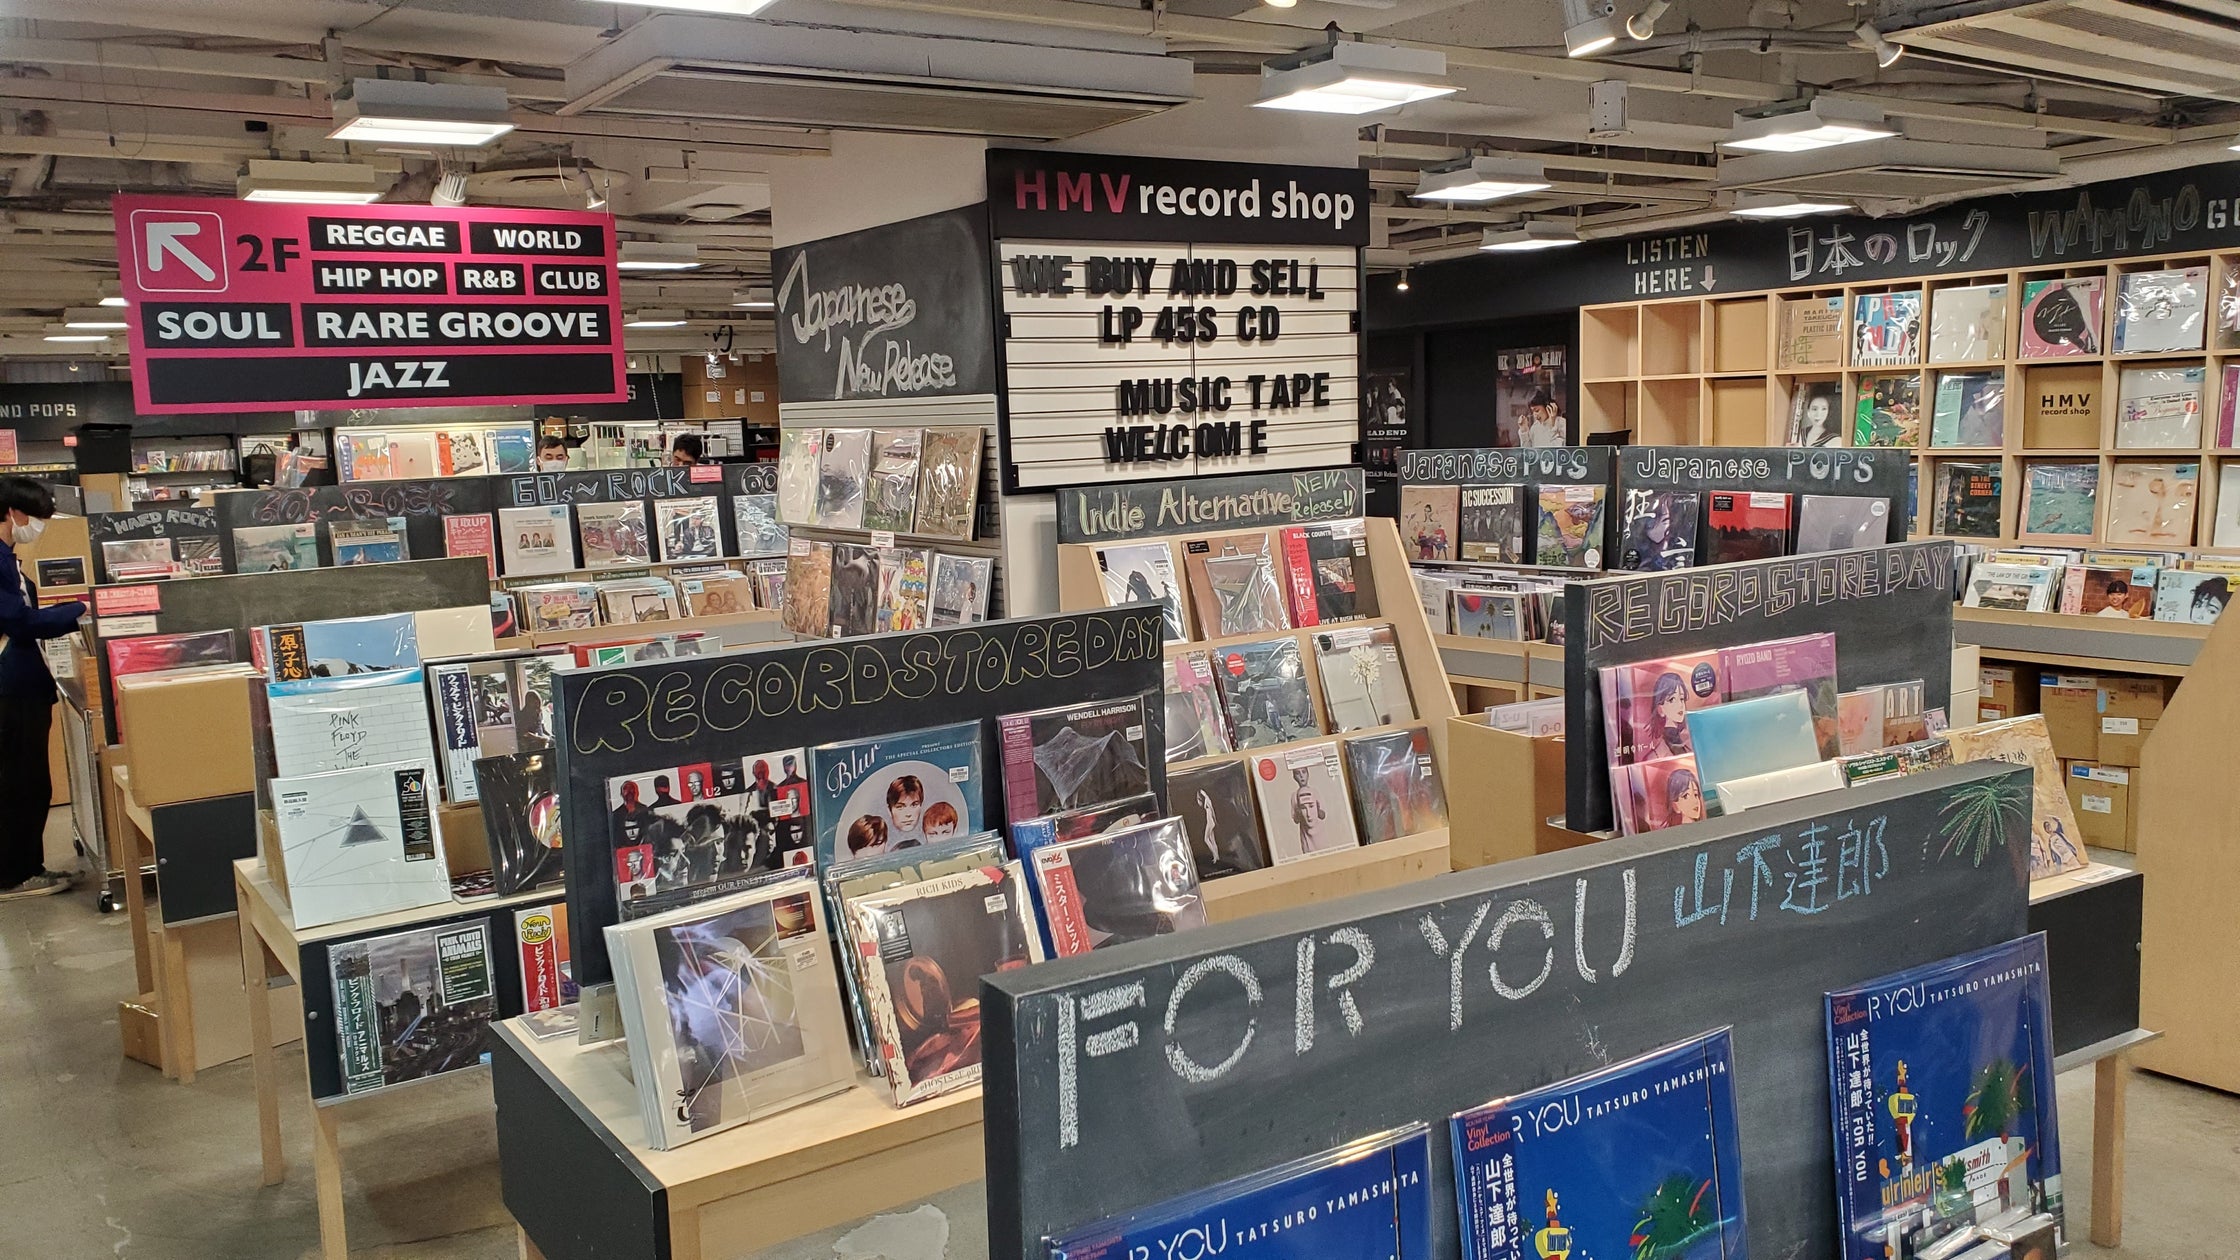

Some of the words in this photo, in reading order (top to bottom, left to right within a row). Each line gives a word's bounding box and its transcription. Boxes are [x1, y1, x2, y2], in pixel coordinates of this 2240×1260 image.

[1014, 169, 1131, 214] HMV
[1139, 179, 1261, 218] record
[1271, 181, 1355, 229] shop
[326, 225, 446, 249] REGGAE
[2028, 184, 2199, 258] WAMONO
[237, 234, 300, 272] 2F
[494, 229, 582, 250] WORLD
[1627, 233, 1709, 265] LISTEN
[1787, 207, 1989, 282] 日本のロック
[321, 268, 374, 289] HIP
[380, 268, 439, 289] HOP
[464, 270, 516, 290] R&B
[540, 271, 600, 291] CLUB
[1015, 254, 1073, 294] WE
[1089, 255, 1156, 295] BUY
[1170, 257, 1237, 295] AND
[1252, 258, 1325, 300] SELL
[1635, 268, 1692, 295] HERE
[777, 250, 917, 353] Japanese
[158, 311, 281, 340] SOUL
[318, 312, 429, 339] RARE
[439, 312, 599, 338] GROOVE
[1104, 305, 1143, 343] LP
[1154, 305, 1217, 342] 45S
[1238, 306, 1280, 341] CD
[347, 361, 450, 397] JAZZ
[835, 337, 883, 400] New
[880, 339, 956, 396] Release
[30, 403, 76, 417] POPS
[1121, 375, 1232, 416] MUSIC
[1248, 372, 1330, 409] TAPE
[2041, 393, 2091, 408] HMV
[2041, 408, 2068, 416] record
[2070, 408, 2091, 417] shop
[1105, 419, 1268, 463] WELCOME
[1401, 451, 1517, 481] Japanese
[1523, 448, 1588, 480] POPS
[1637, 448, 1770, 484] Japanese
[1786, 450, 1875, 483] POPS
[606, 467, 688, 500] ROCK
[1296, 471, 1341, 497] NEW
[1079, 491, 1145, 535] Indie
[1156, 486, 1292, 528] Alternative
[1292, 490, 1352, 519] Release!!
[114, 512, 163, 535] HARD
[166, 508, 209, 528] ROCK
[1311, 530, 1331, 538] COUNTR
[1589, 568, 1761, 652] RECORD
[1763, 551, 1880, 618] STORE
[1884, 546, 1952, 594] DAY
[280, 633, 303, 681] 原子心
[573, 644, 891, 754] RECORD
[890, 620, 1080, 698] STORE
[1086, 613, 1164, 670] DAY
[1066, 708, 1101, 721] WENDELL
[1101, 703, 1137, 717] HARRISON
[1885, 685, 1922, 718] ART
[329, 710, 359, 729] PINK
[331, 726, 367, 747] FLOYD
[336, 744, 362, 762] THE
[827, 743, 881, 799] Blur
[705, 787, 722, 798] U2
[915, 885, 939, 897] RICH
[942, 878, 964, 890] KIDS
[1673, 814, 1890, 929] 山下達郎
[1053, 873, 1079, 955] ミスター・ビッグ
[1883, 983, 1927, 1016] YOU
[1930, 980, 1979, 1004] TATSURO
[1984, 961, 2041, 987] YAMASHITA
[1058, 926, 1378, 1150] FOR
[1418, 867, 1638, 1031] YOU
[1847, 1033, 1864, 1109] 山下達郎
[1528, 1095, 1580, 1137] YOU
[1587, 1087, 1649, 1120] TATSURO
[1654, 1061, 1726, 1096] YAMASHITA
[1466, 1123, 1489, 1141] Vinyl
[1467, 1130, 1511, 1152] Collection
[1853, 1116, 1865, 1147] FOR
[1857, 1153, 1867, 1181] YOU
[1237, 1205, 1318, 1245] TATSURO
[1326, 1170, 1420, 1215] YAMASHITA
[1485, 1158, 1507, 1249] 山下達郎
